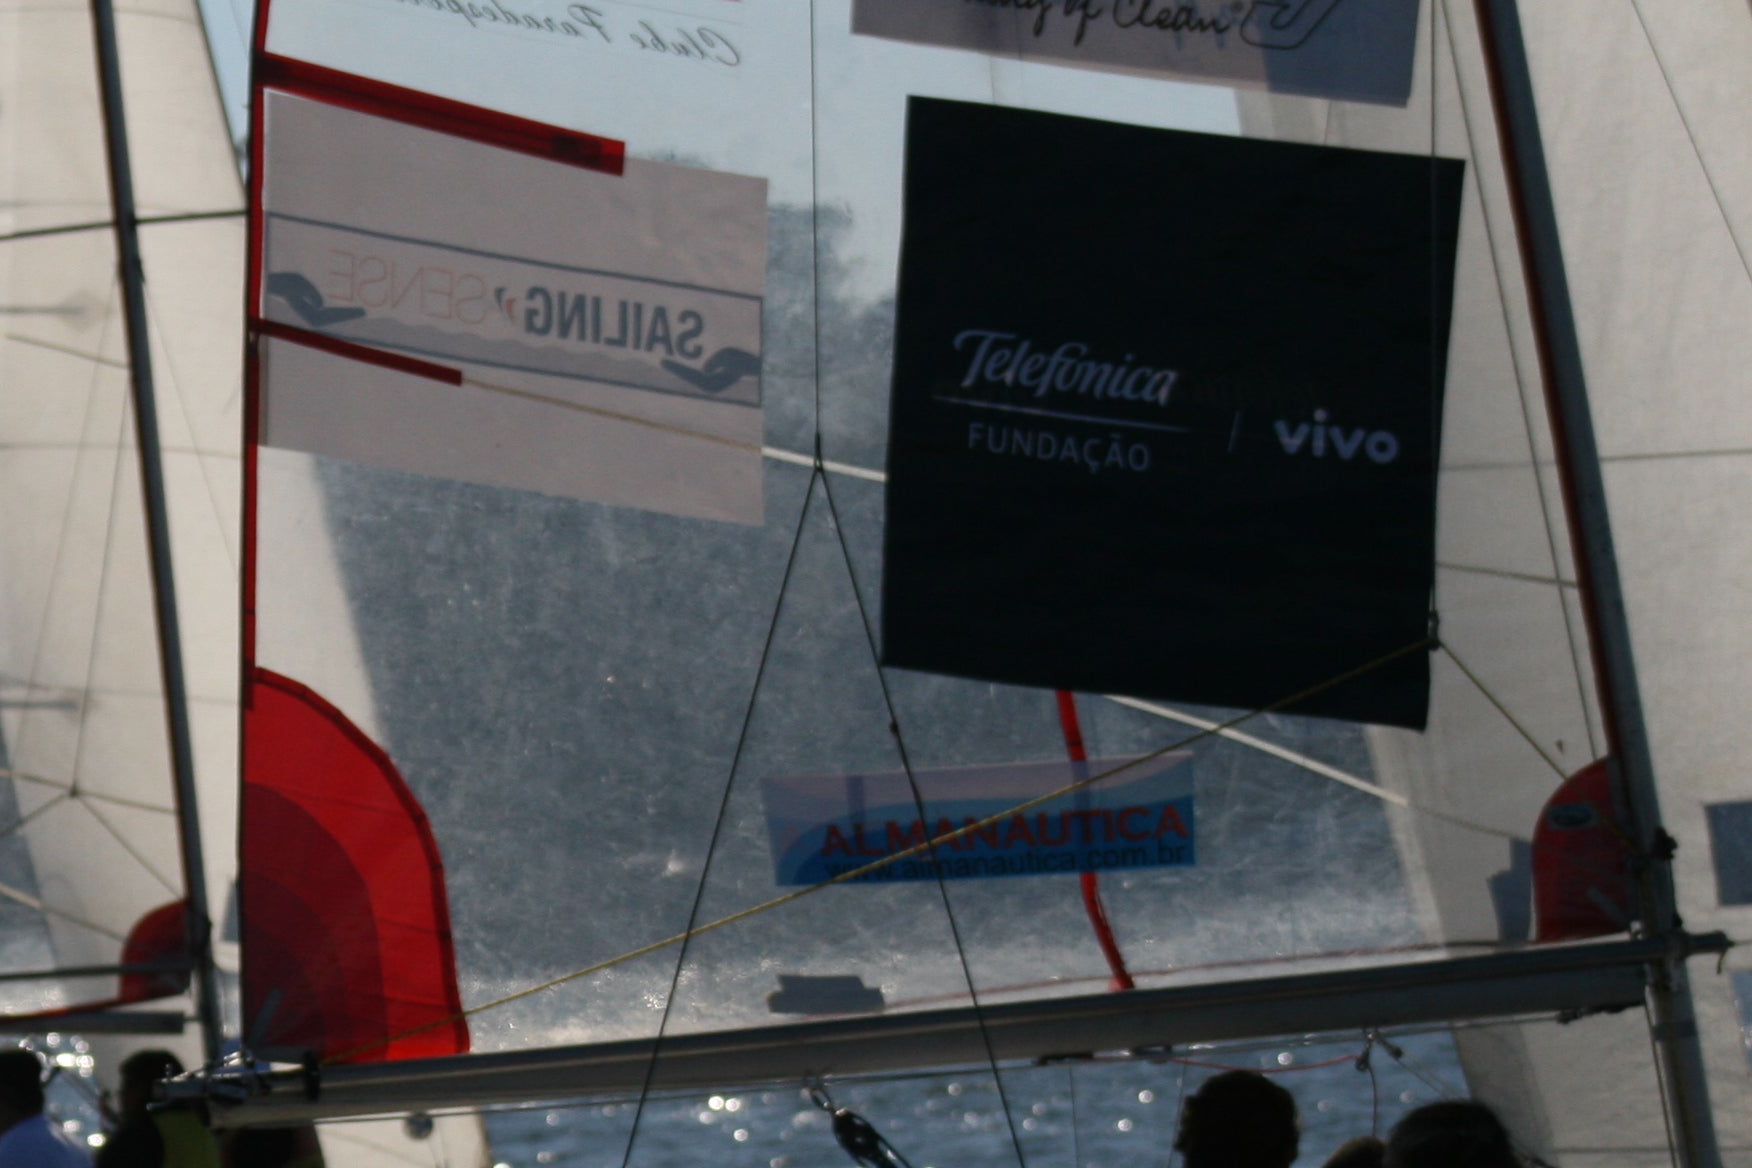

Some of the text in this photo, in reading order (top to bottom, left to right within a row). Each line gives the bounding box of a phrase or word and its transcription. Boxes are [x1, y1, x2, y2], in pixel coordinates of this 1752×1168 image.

[968, 421, 1149, 473] FUNDAÇÃO
[1275, 410, 1400, 463] vivo
[822, 805, 1189, 857] ALMANAUTICA
